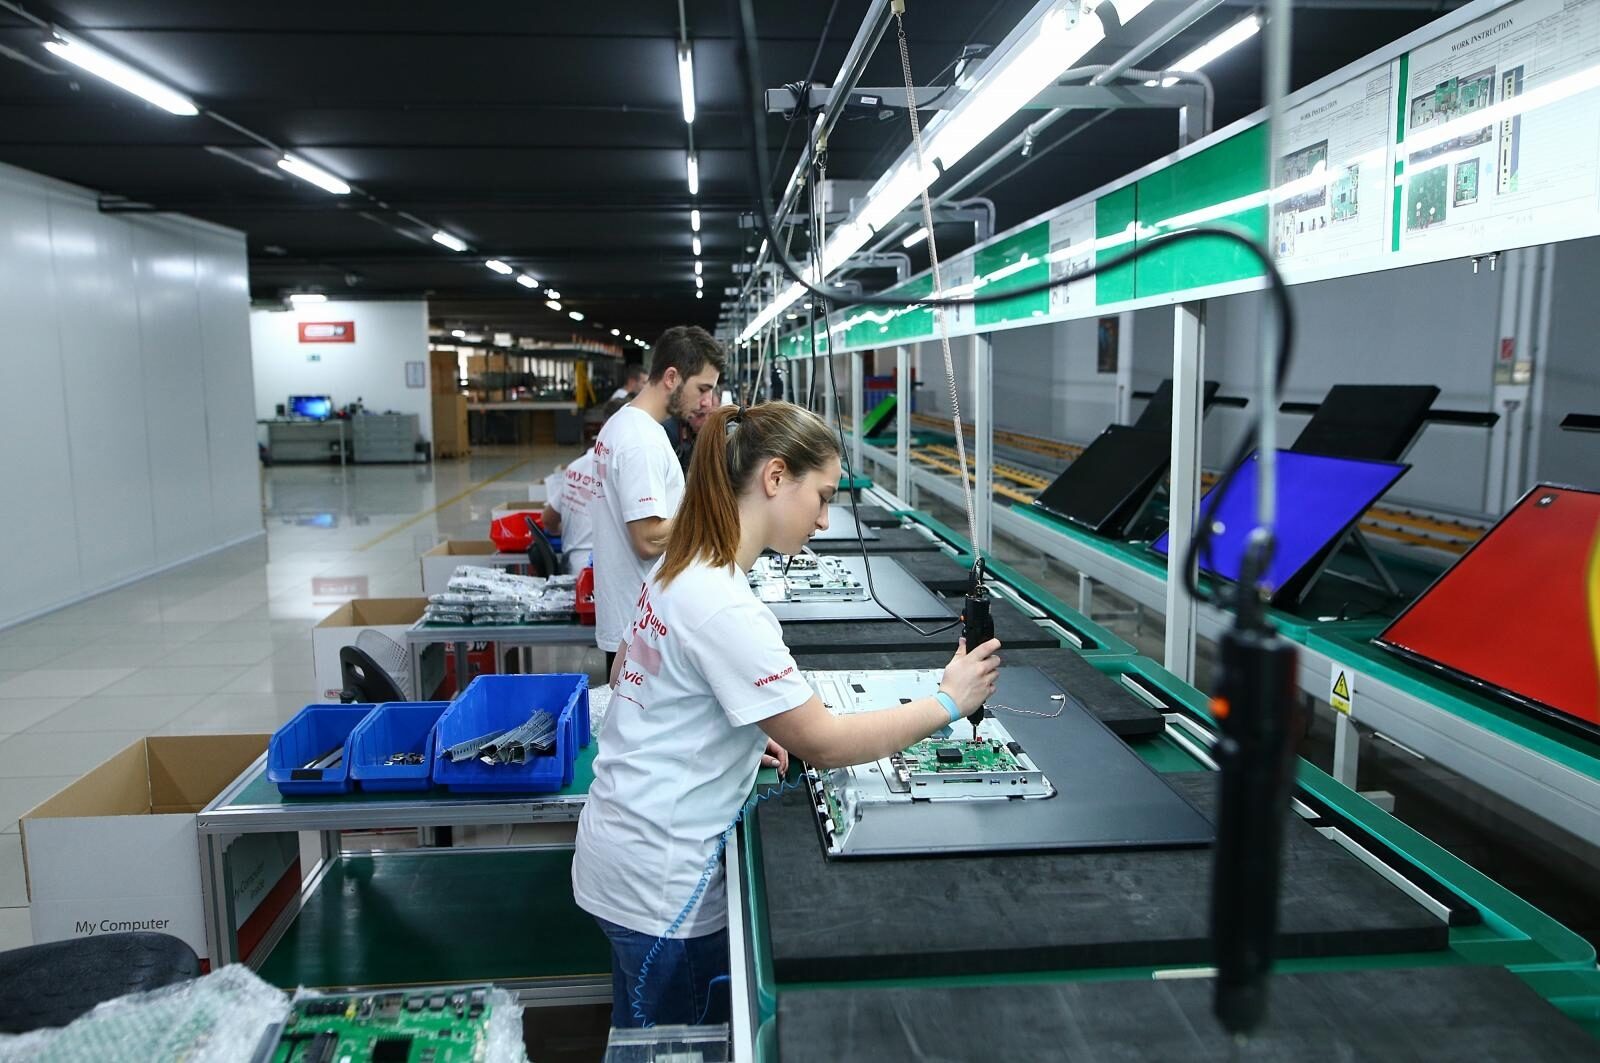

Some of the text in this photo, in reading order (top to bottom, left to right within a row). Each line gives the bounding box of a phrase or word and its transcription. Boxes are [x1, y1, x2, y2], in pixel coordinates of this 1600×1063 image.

[1451, 18, 1514, 52] WORK INSTRUCTION
[650, 614, 668, 636] UHD
[754, 666, 794, 687] vivax.com
[75, 918, 170, 935] My Computer
